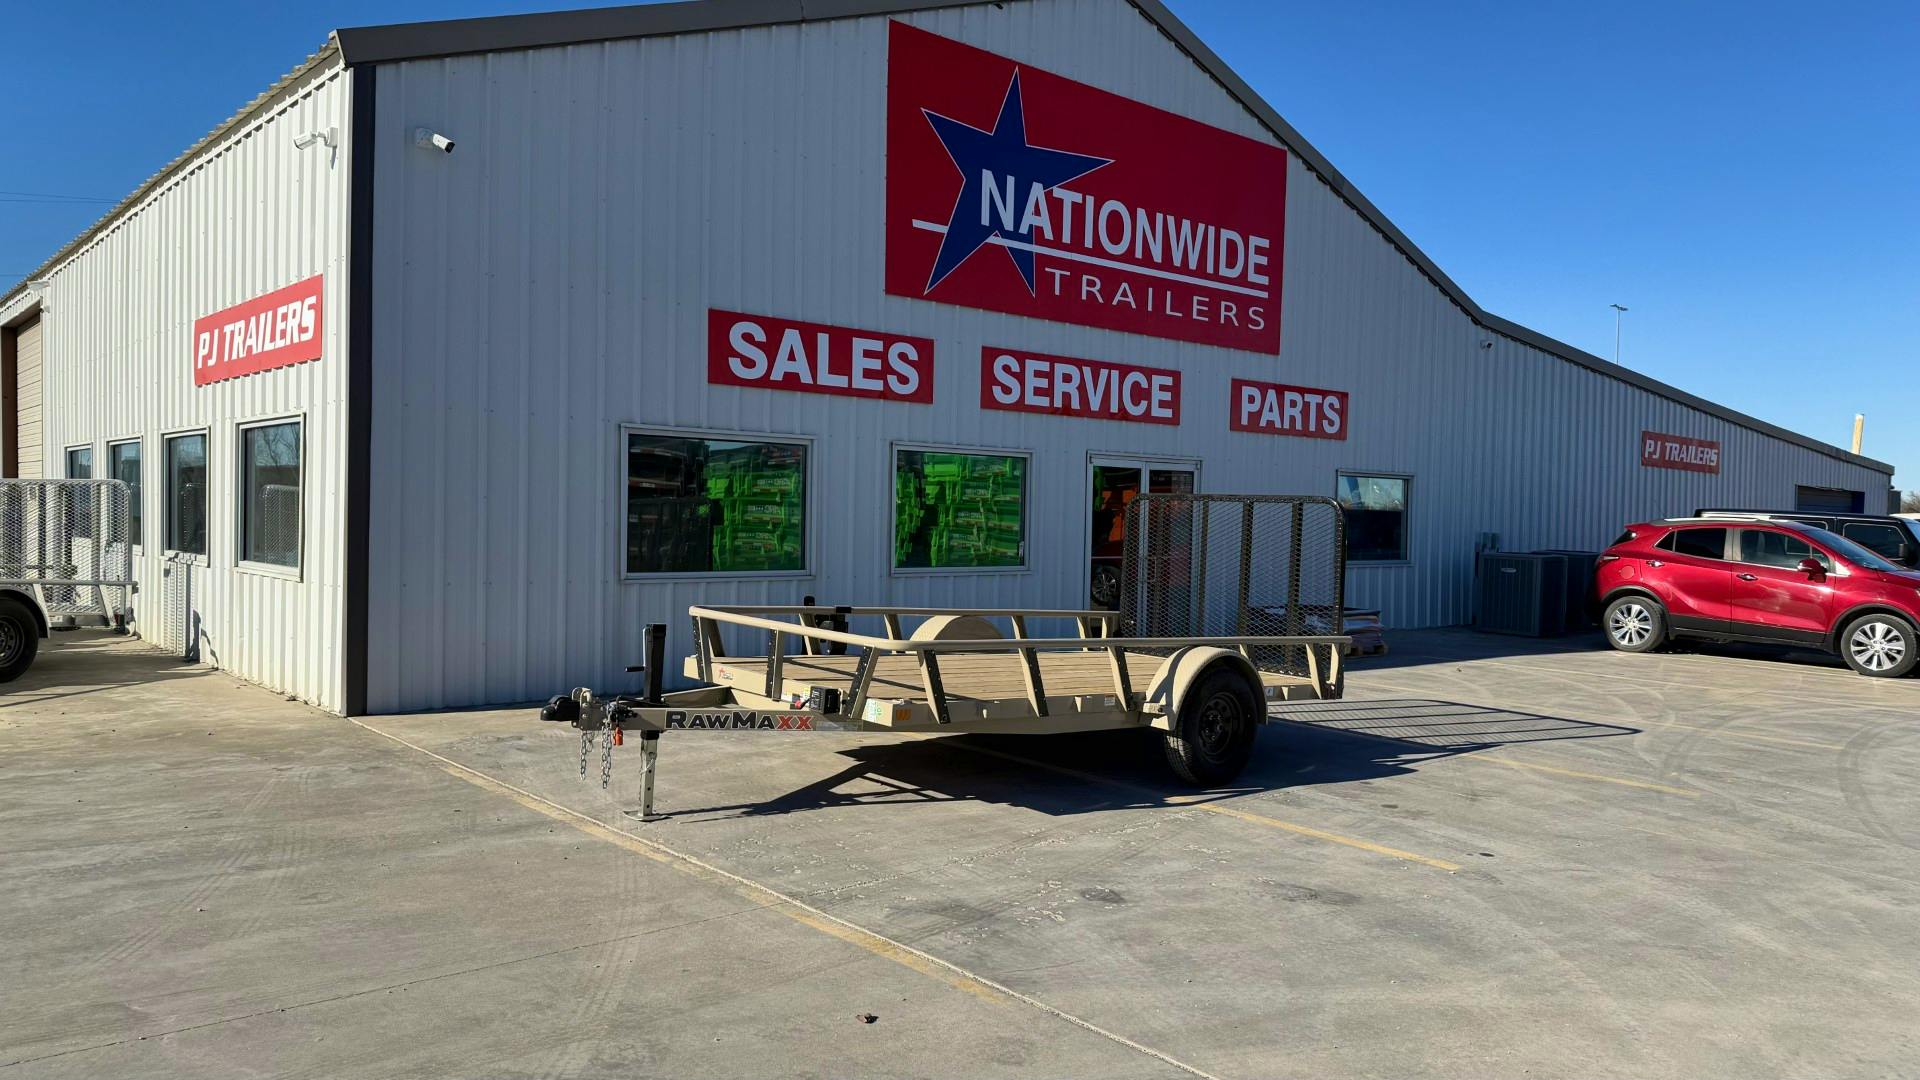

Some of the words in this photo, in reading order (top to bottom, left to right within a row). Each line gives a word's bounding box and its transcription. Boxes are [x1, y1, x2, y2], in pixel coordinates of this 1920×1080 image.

[980, 168, 1270, 286] NATIONWIDE
[1044, 266, 1266, 331] TRAILERS
[197, 328, 219, 369] PJ
[223, 295, 317, 362] TRAILERS
[728, 321, 920, 395] SALES
[991, 354, 1174, 418] SERVICE
[1240, 385, 1342, 434] PARTS
[1644, 439, 1661, 459] PJ
[1664, 441, 1719, 466] TRAILERS
